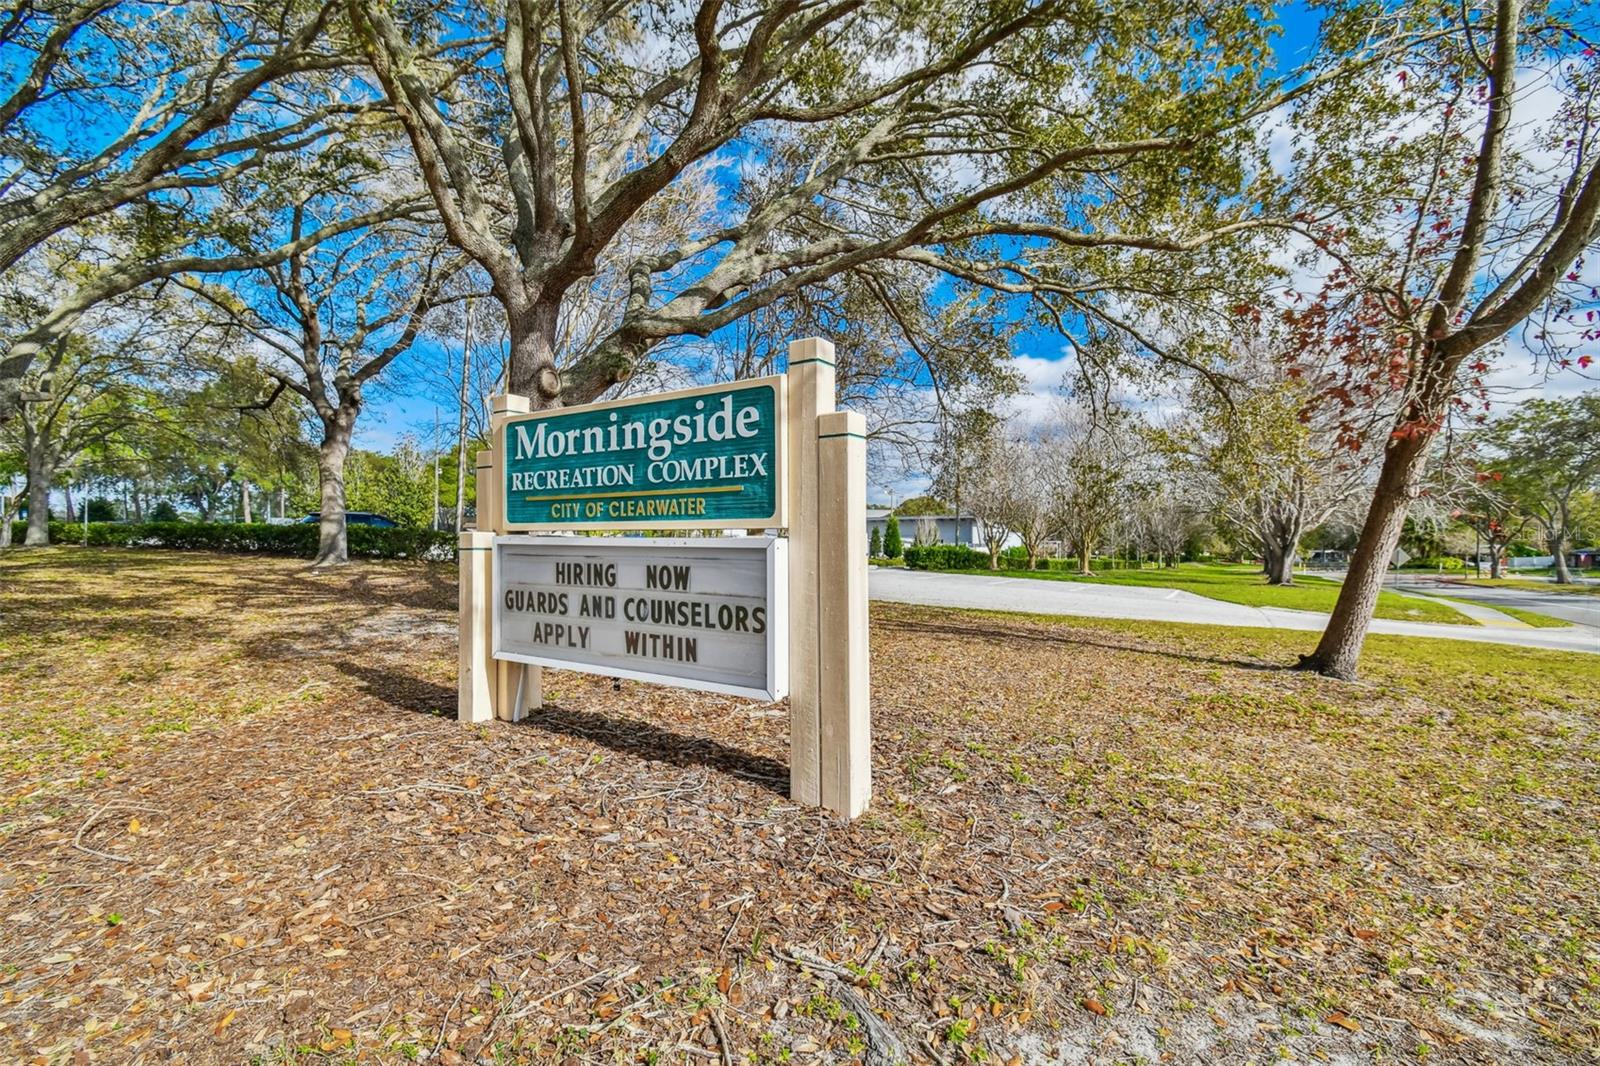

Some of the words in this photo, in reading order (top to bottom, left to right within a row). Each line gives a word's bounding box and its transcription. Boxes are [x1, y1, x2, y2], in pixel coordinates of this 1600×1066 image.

[514, 394, 760, 461] Morningside
[511, 464, 635, 492] RECREATION
[647, 453, 768, 483] COMPLEX
[551, 503, 580, 519] CITY
[585, 502, 604, 517] OF
[608, 497, 706, 517] CLEARWATER
[555, 562, 616, 587] HIRING
[646, 565, 690, 591] NOW
[505, 589, 568, 615] GUARDS
[579, 594, 616, 619] AND
[623, 598, 766, 633] COUNSELORS
[533, 621, 590, 649] APPLY
[624, 630, 698, 663] WITHIN
